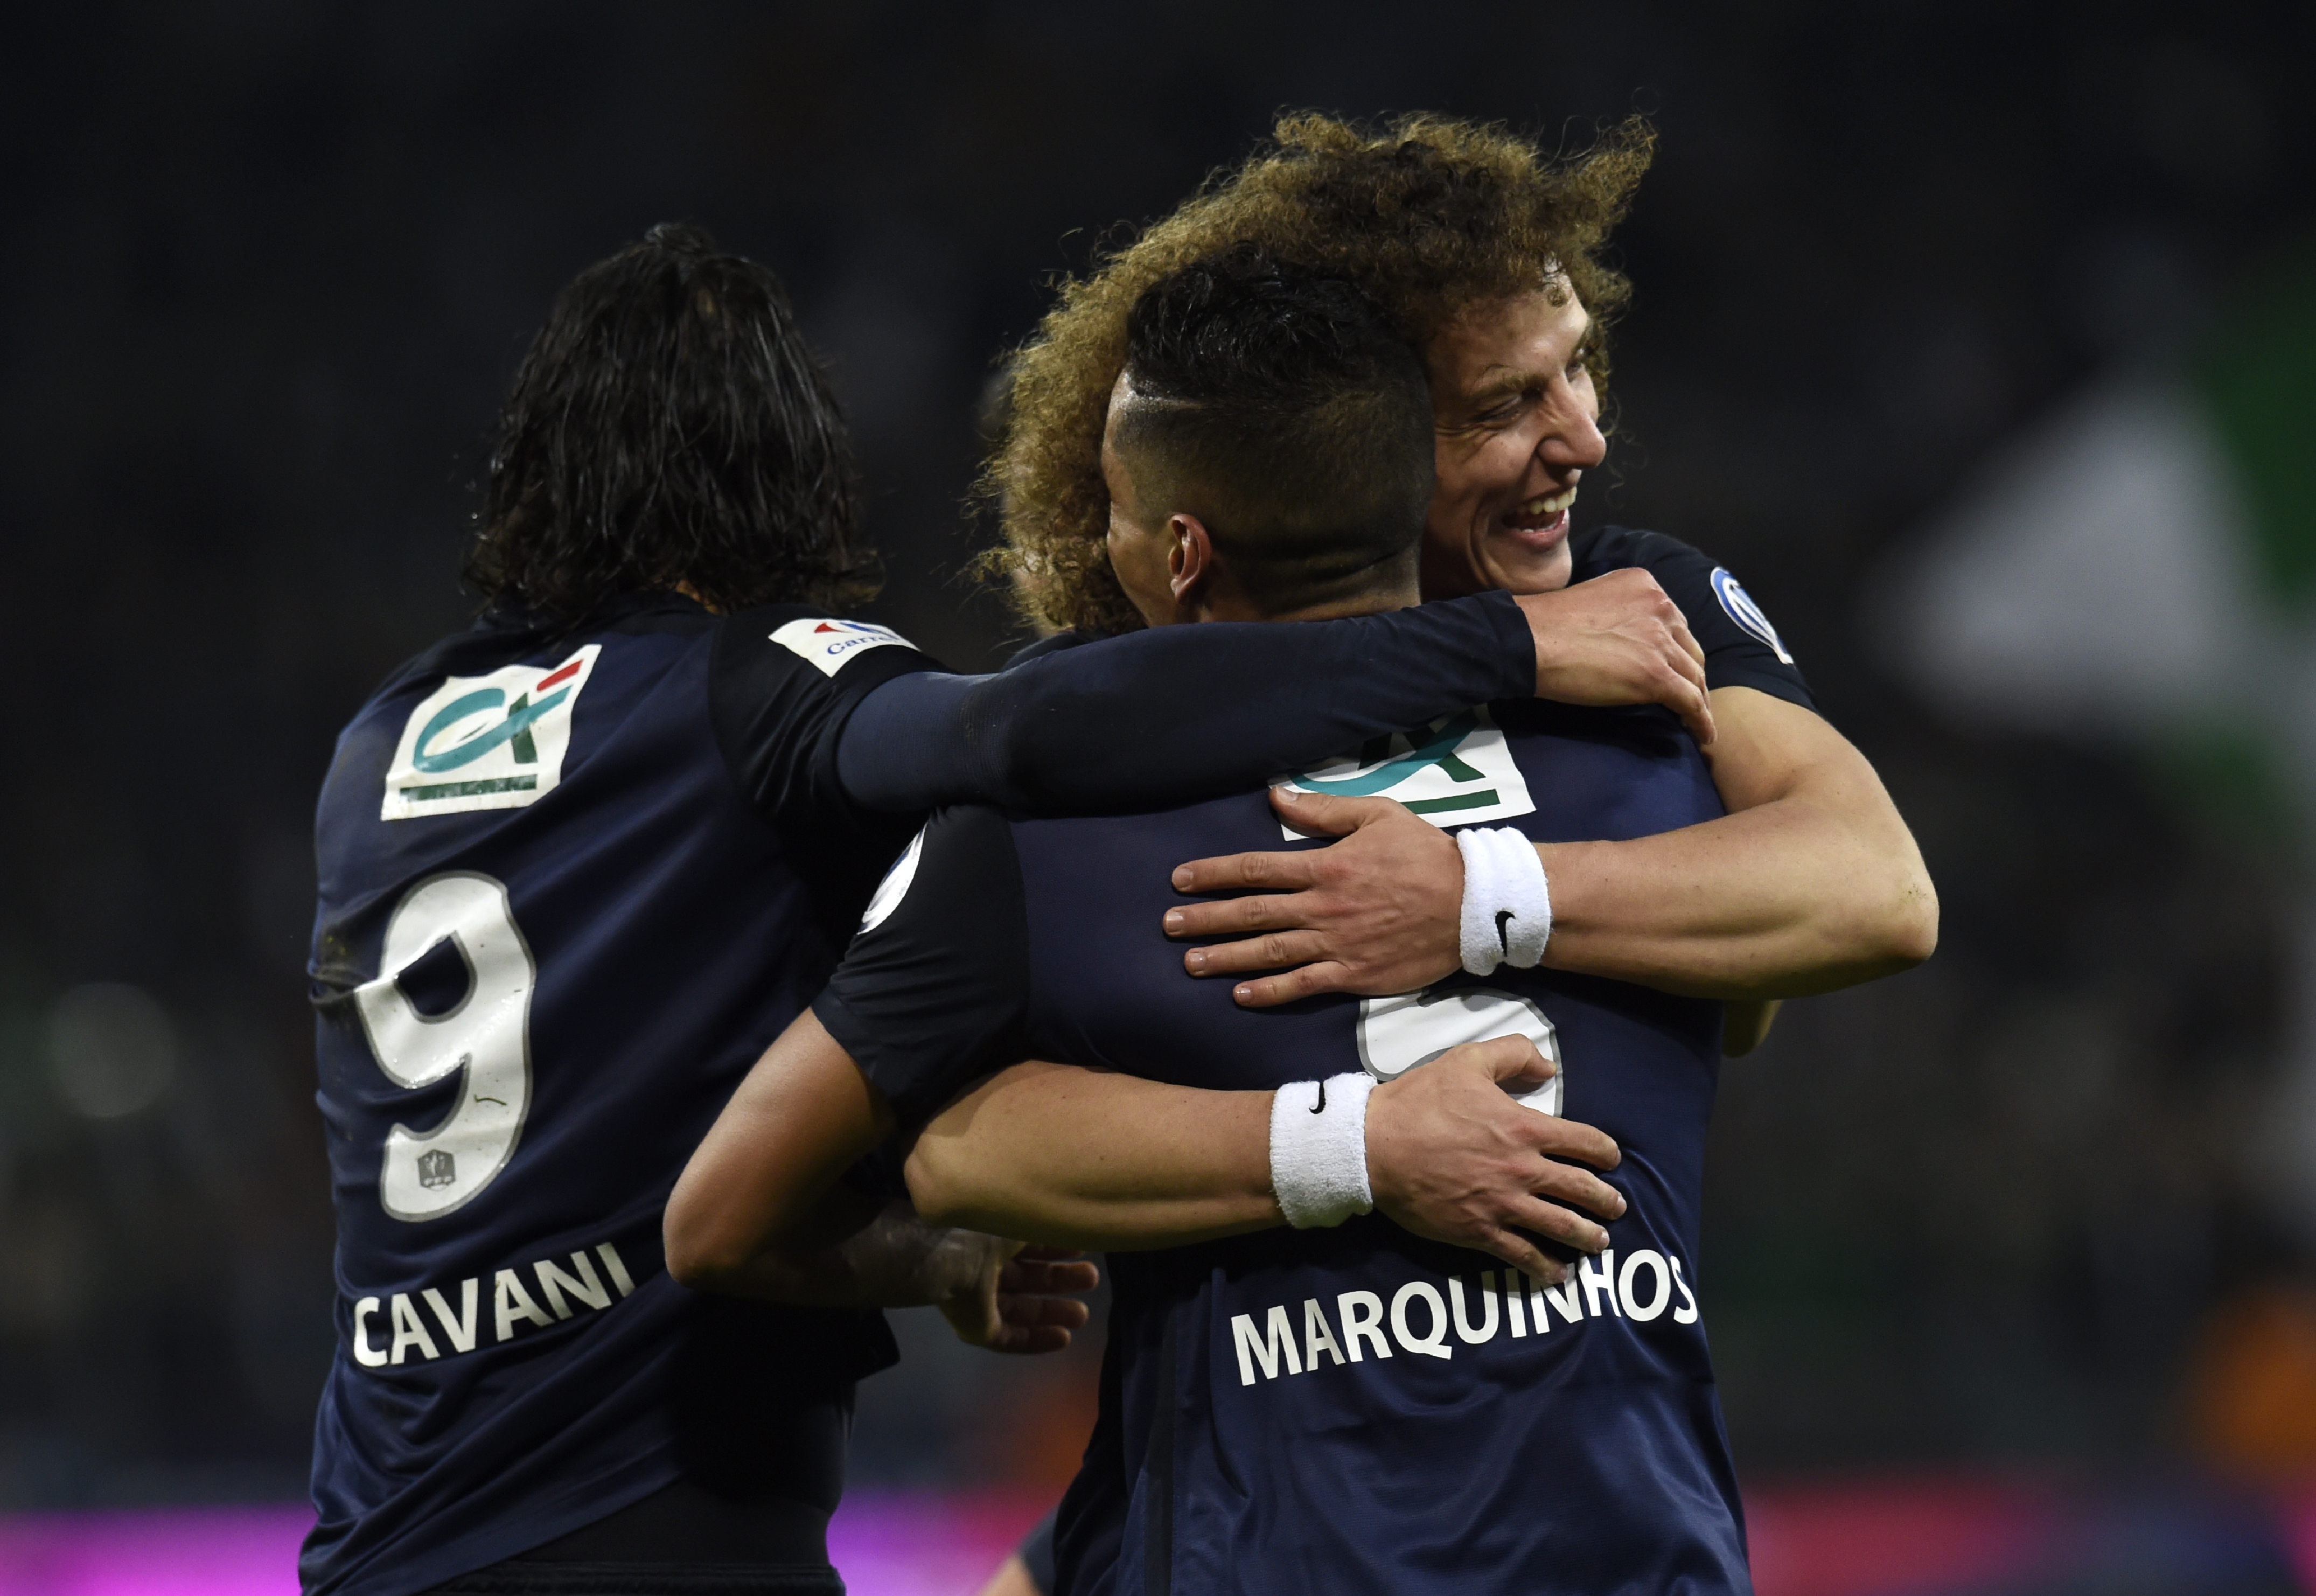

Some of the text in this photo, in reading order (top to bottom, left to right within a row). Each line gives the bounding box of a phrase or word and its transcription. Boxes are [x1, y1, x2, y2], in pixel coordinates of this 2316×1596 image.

[354, 869, 536, 1223] 9
[353, 1242, 636, 1367] CAVANI
[1231, 1249, 1698, 1386] MARQUINHOS
